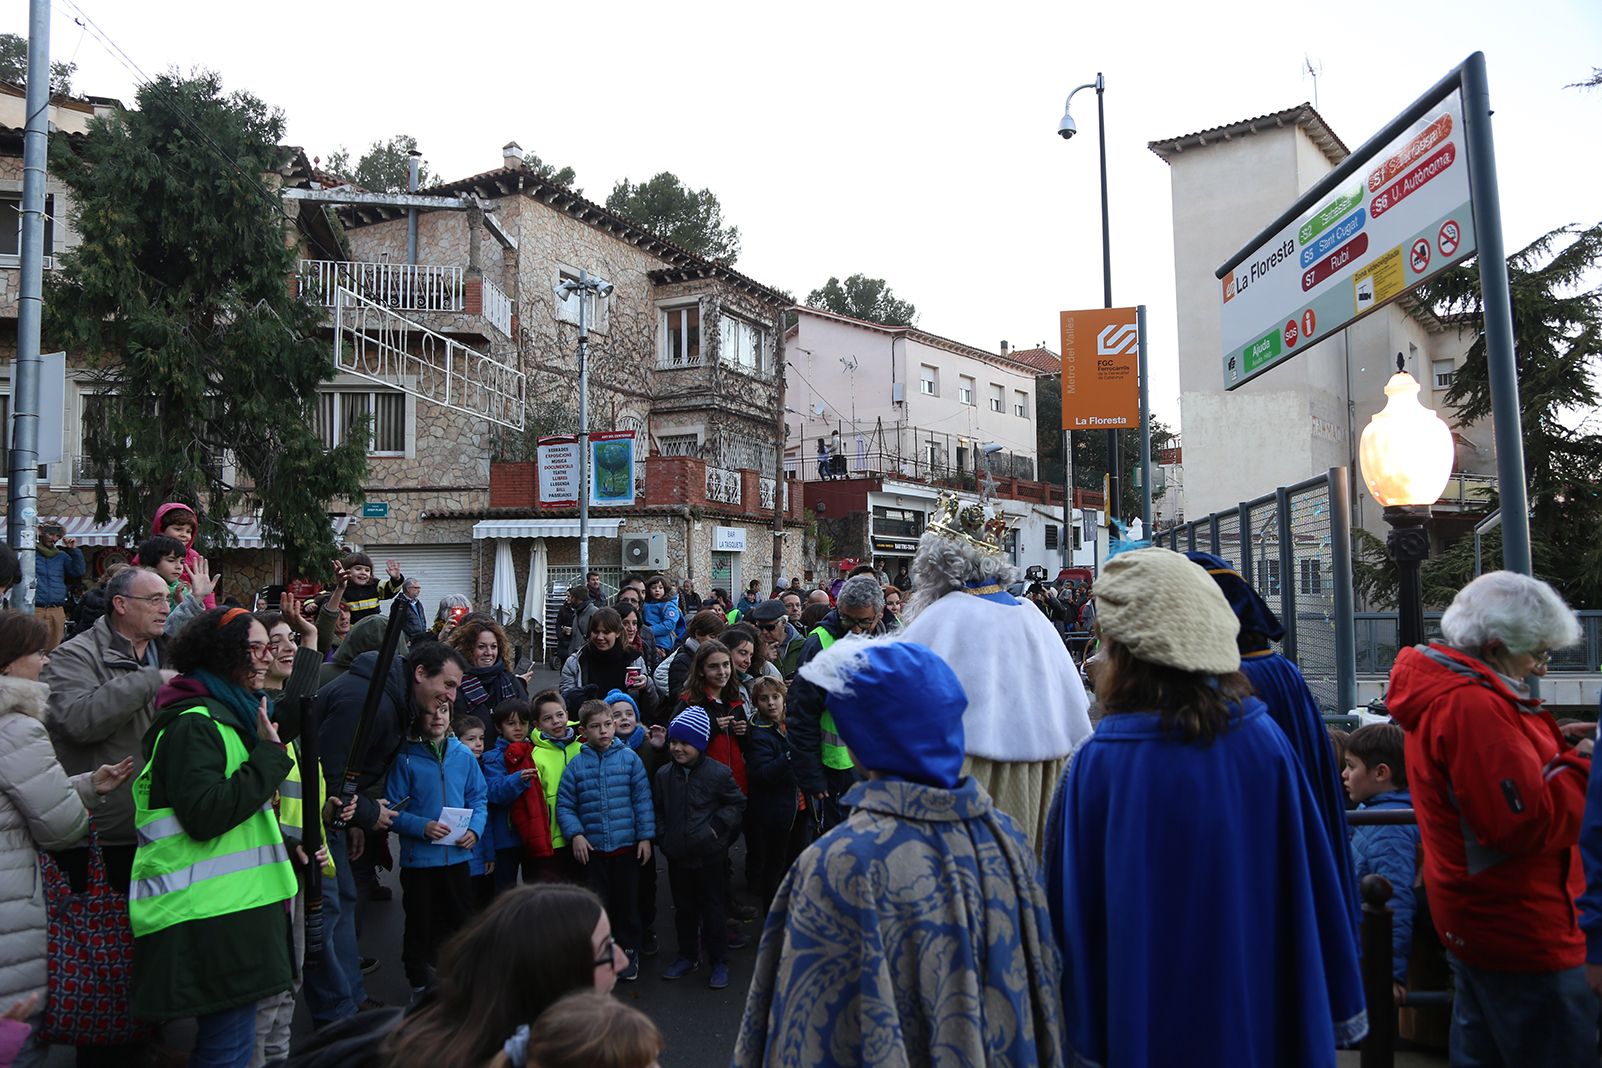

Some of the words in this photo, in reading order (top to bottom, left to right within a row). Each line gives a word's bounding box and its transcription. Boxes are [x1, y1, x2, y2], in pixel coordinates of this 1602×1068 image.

[1375, 194, 1389, 212] S6
[1391, 188, 1402, 201] U.
[1403, 152, 1452, 193] Autònoma
[1302, 225, 1313, 240] S2
[1304, 247, 1314, 264] S5
[1319, 233, 1336, 253] Sant
[1336, 216, 1359, 240] Cugat
[1236, 274, 1249, 294] La
[1250, 239, 1295, 283] Floresta
[1305, 271, 1316, 287] S7
[1066, 317, 1075, 347] Vallès
[1285, 327, 1298, 341] SOS
[1066, 350, 1076, 363] del
[1251, 339, 1271, 358] Ajuda
[1067, 365, 1076, 395] Metro
[1075, 416, 1087, 426] La
[1089, 416, 1127, 425] Floresta
[727, 530, 736, 538] BAR
[725, 541, 744, 549] TASQUETA
